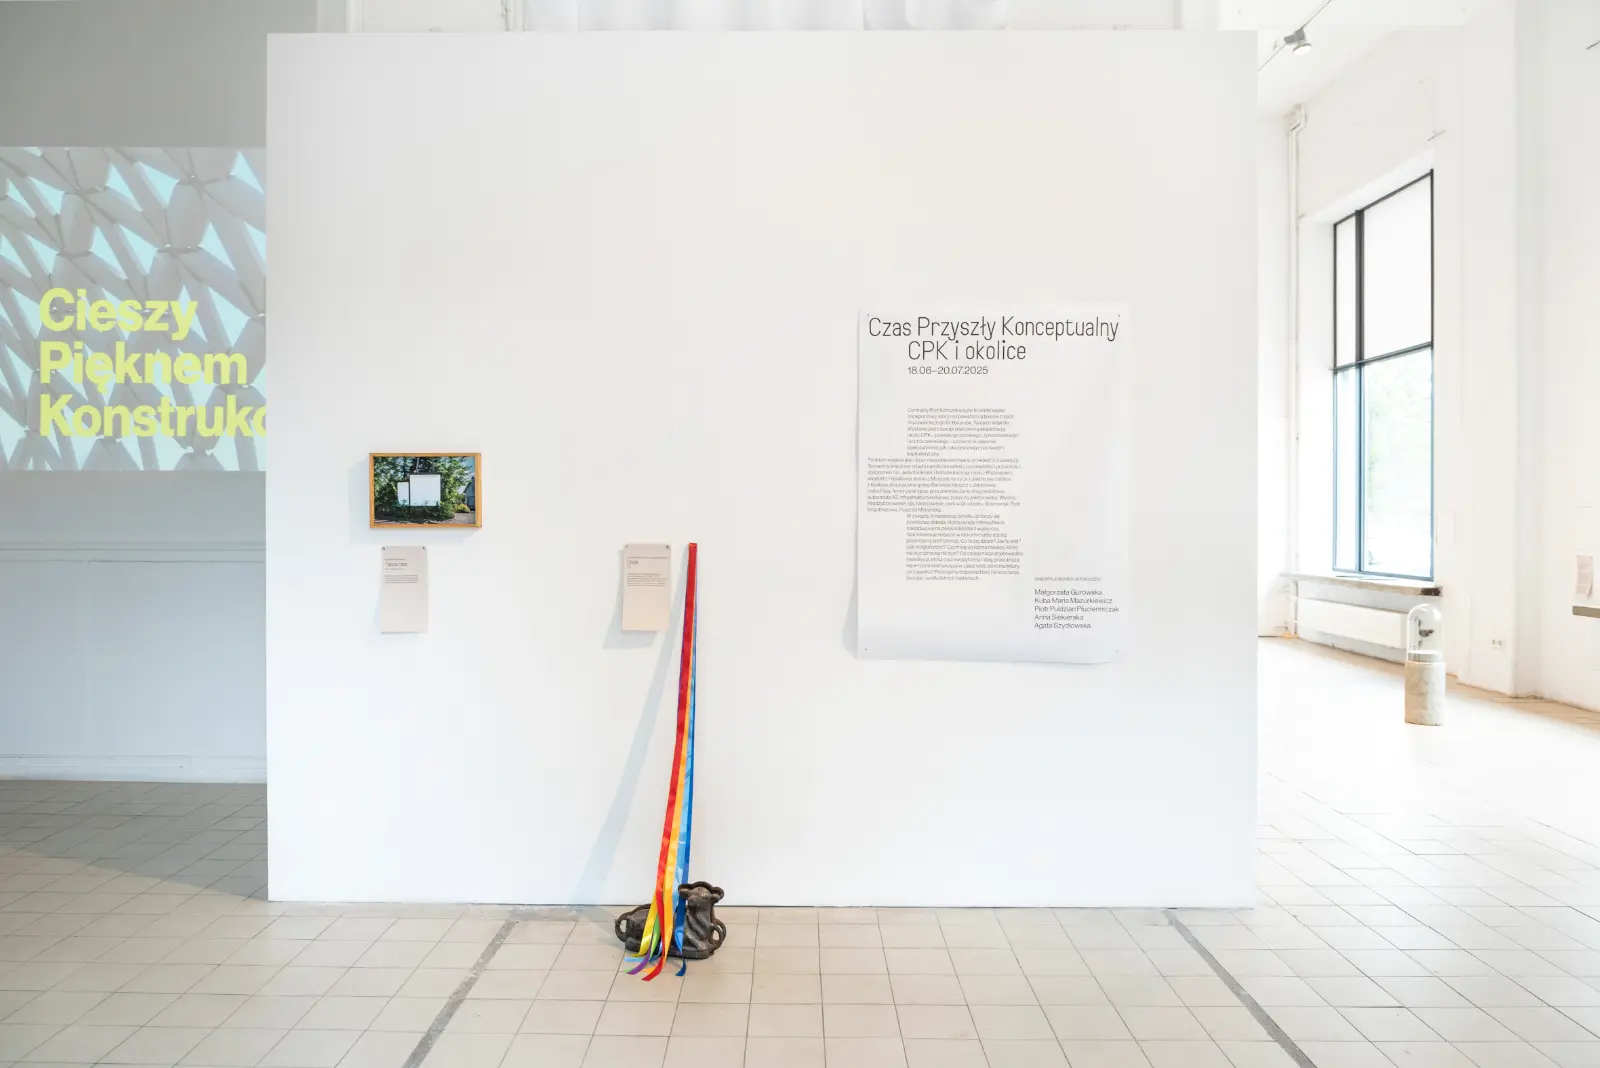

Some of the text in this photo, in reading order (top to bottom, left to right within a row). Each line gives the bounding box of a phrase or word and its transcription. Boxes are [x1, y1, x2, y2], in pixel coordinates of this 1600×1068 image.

[39, 287, 198, 341] Cieszy
[868, 315, 1119, 342] Czas Przyszły Konceptualny
[39, 340, 248, 394] Pięknem
[908, 340, 1026, 360] CPK i okolice
